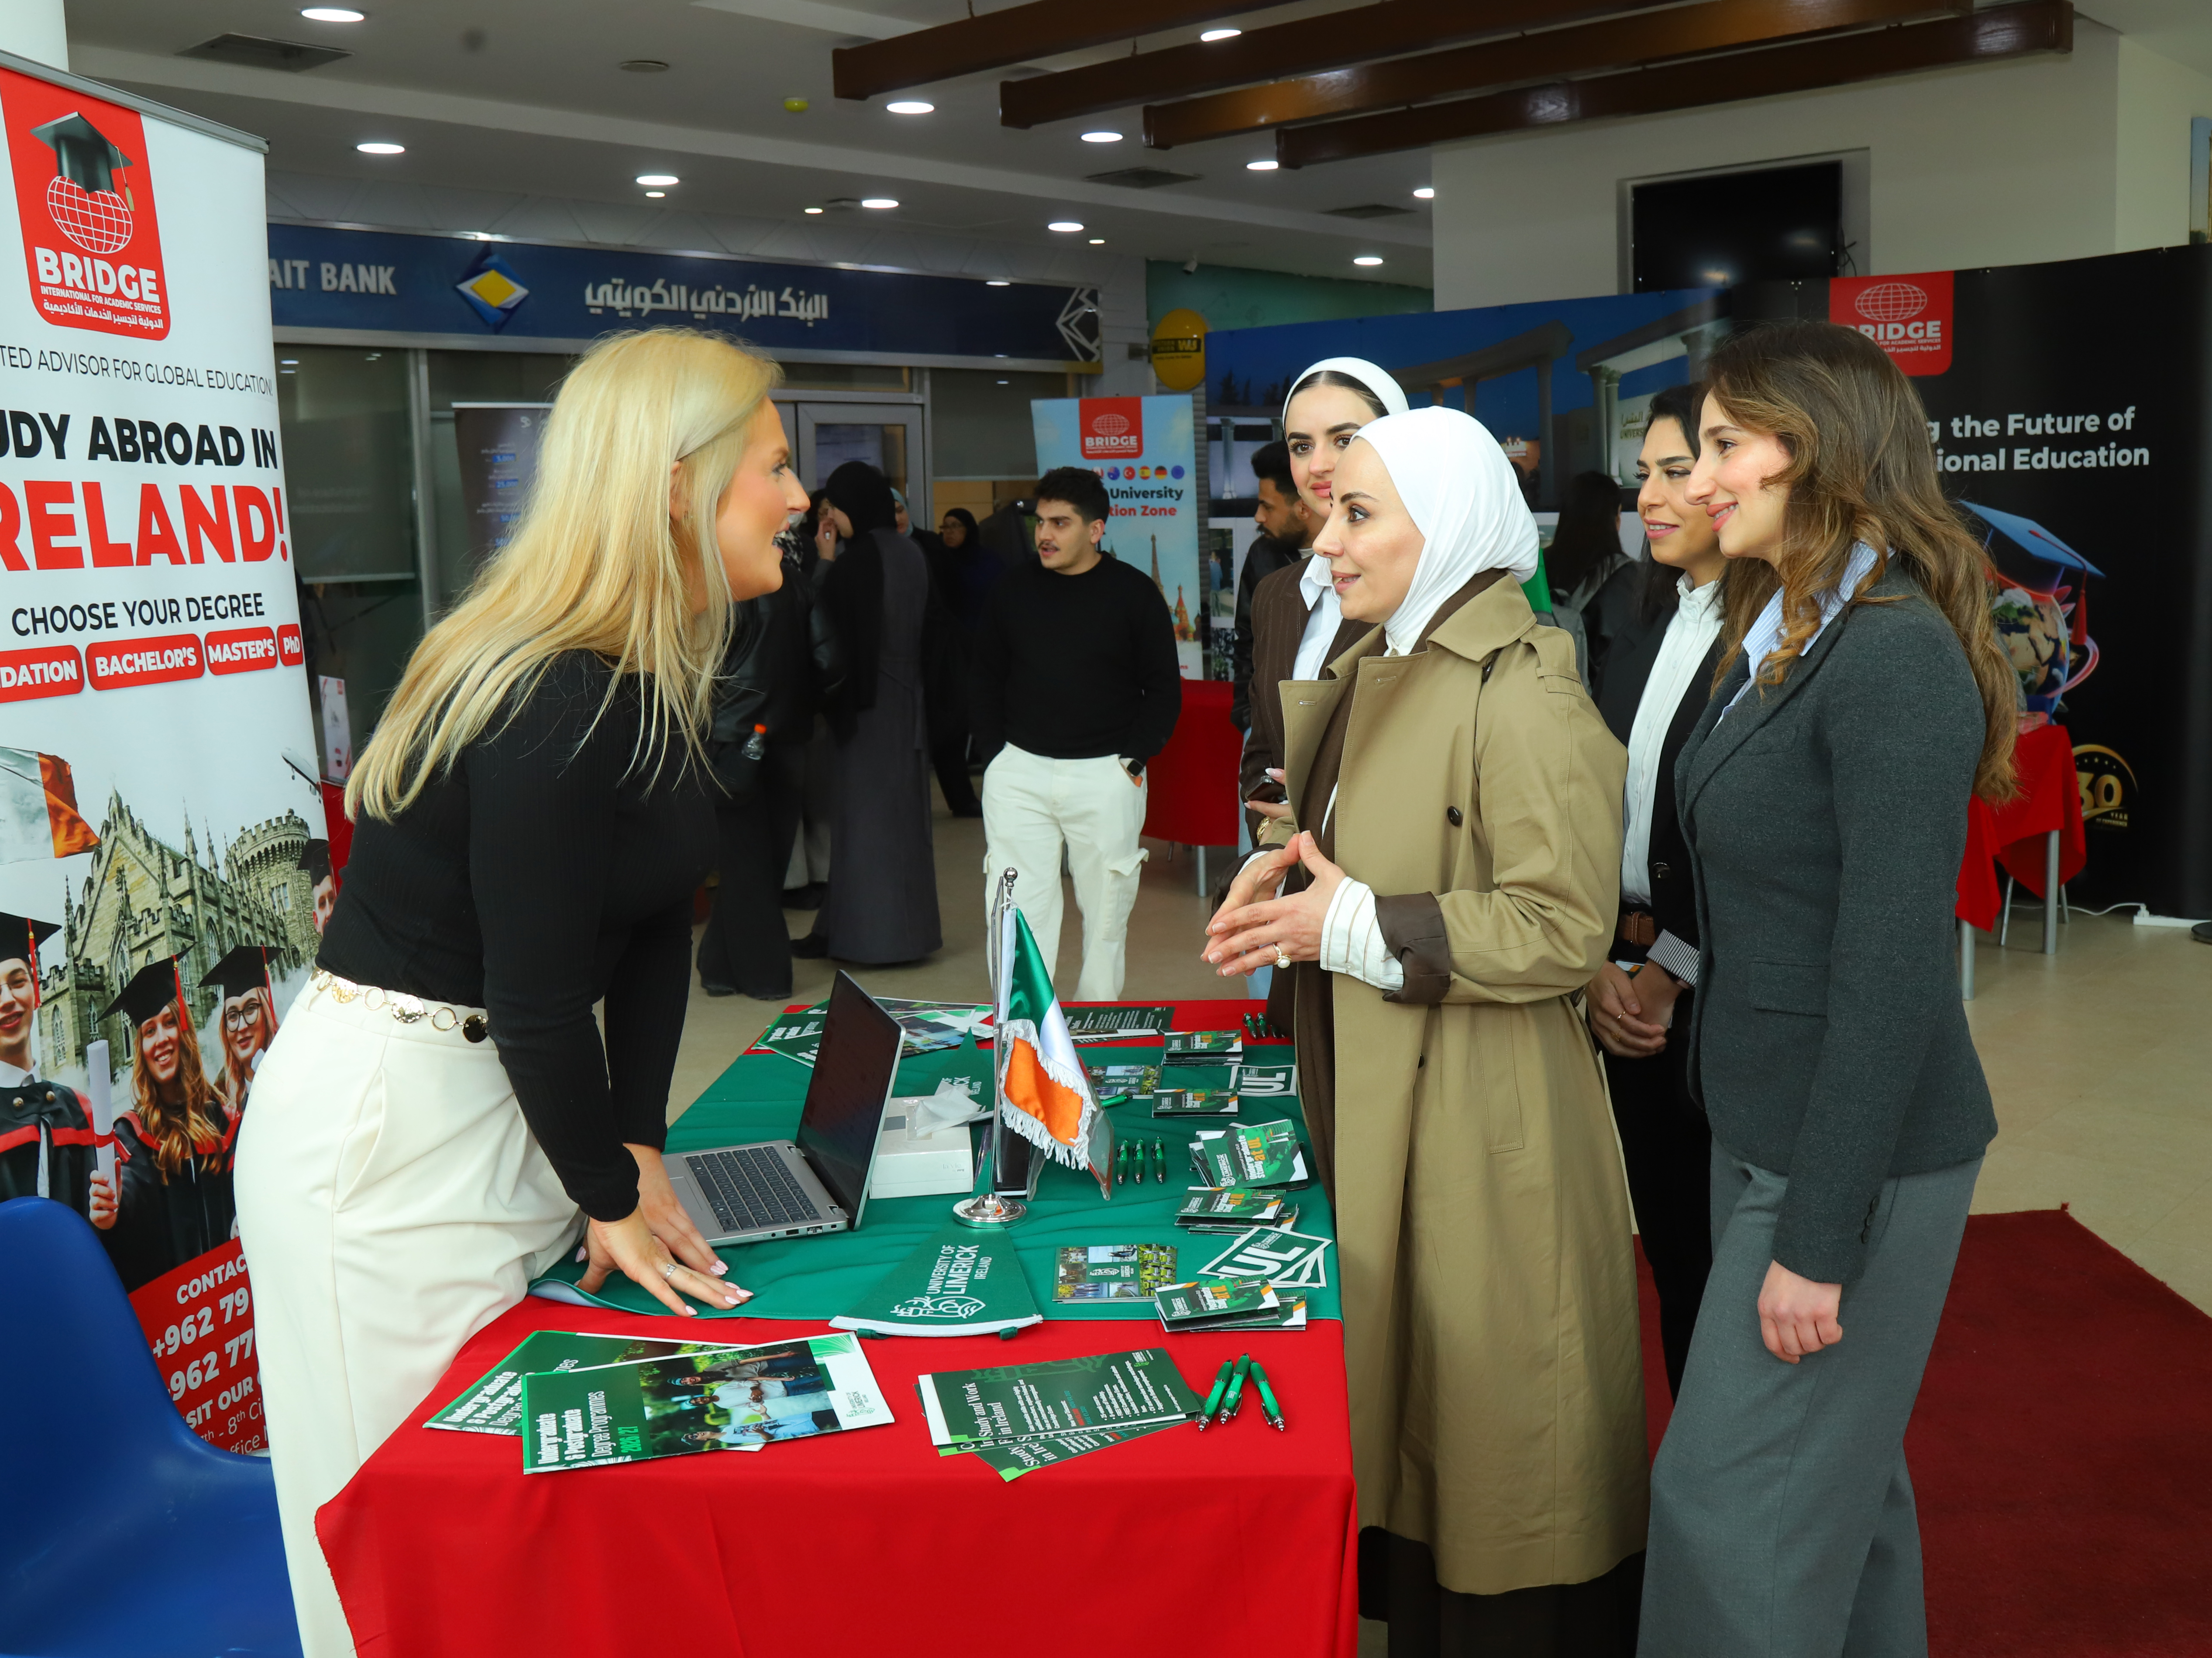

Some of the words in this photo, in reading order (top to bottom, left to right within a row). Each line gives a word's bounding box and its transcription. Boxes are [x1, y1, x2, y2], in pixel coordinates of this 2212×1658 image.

[34, 247, 160, 303] BRIDGE
[269, 258, 310, 289] AIT
[320, 262, 397, 296] BANK
[41, 286, 91, 302] INTERNATIONAL
[92, 294, 103, 304] FOR
[104, 297, 133, 310] ACADEMIC
[134, 303, 162, 314] SERVICES
[585, 278, 688, 317] الكويتي
[778, 287, 828, 327] البنك
[85, 306, 112, 320] الخدمات
[113, 313, 138, 327] لتجسير
[138, 315, 163, 330] الدولية
[1849, 321, 1941, 341] RIDGE
[38, 352, 110, 377] ADVISOR
[114, 359, 142, 381] FOR
[145, 364, 203, 388] GLOBAL
[208, 371, 273, 396] EDUCATION!
[1951, 415, 2000, 438] the
[2008, 413, 2099, 437] Future
[2108, 406, 2135, 431] of
[88, 416, 245, 466] ABROAD
[251, 428, 278, 469] IN
[1085, 435, 1138, 446] BRIDGE
[2014, 442, 2149, 471] Education
[1110, 486, 1183, 501] University
[1141, 505, 1177, 516] Zone
[12, 603, 118, 636] CHOOSE
[123, 599, 180, 627] YOUR
[186, 593, 265, 622] DEGREE
[0, 660, 78, 688] DATION
[283, 636, 301, 654] PhD
[1241, 1072, 1286, 1092] UL
[1247, 1137, 1261, 1148] UL
[1251, 1150, 1265, 1161] at
[1220, 1154, 1230, 1176] LIMERICK
[1238, 1135, 1259, 1179] Undergraduate
[1254, 1161, 1265, 1178] Study
[927, 1255, 953, 1294] UNIVERSITY
[941, 1245, 956, 1255] OF
[943, 1245, 980, 1295] LIMERICK
[974, 1256, 992, 1280] IRELAND
[1217, 1246, 1306, 1274] UL
[177, 1254, 247, 1304] CONTAC
[1201, 1287, 1218, 1310] Postgraduate
[153, 1307, 214, 1358] +962
[220, 1287, 249, 1324] 79
[168, 1351, 219, 1401] 962
[225, 1328, 254, 1368] 77
[182, 1399, 213, 1430] SIT
[218, 1376, 254, 1410] OUR
[443, 1371, 518, 1423] Undergraduate
[852, 1391, 865, 1409] LIMERICK
[962, 1383, 980, 1402] Work
[588, 1390, 612, 1434] Programmes
[968, 1403, 986, 1415] and
[987, 1402, 1009, 1427] Ireland
[538, 1413, 562, 1464] Undergraduate
[561, 1409, 588, 1455] Postgraduate
[974, 1417, 993, 1437] Study
[592, 1432, 616, 1457] Degree
[1008, 1444, 1041, 1467] Study
[1042, 1452, 1058, 1462] in
